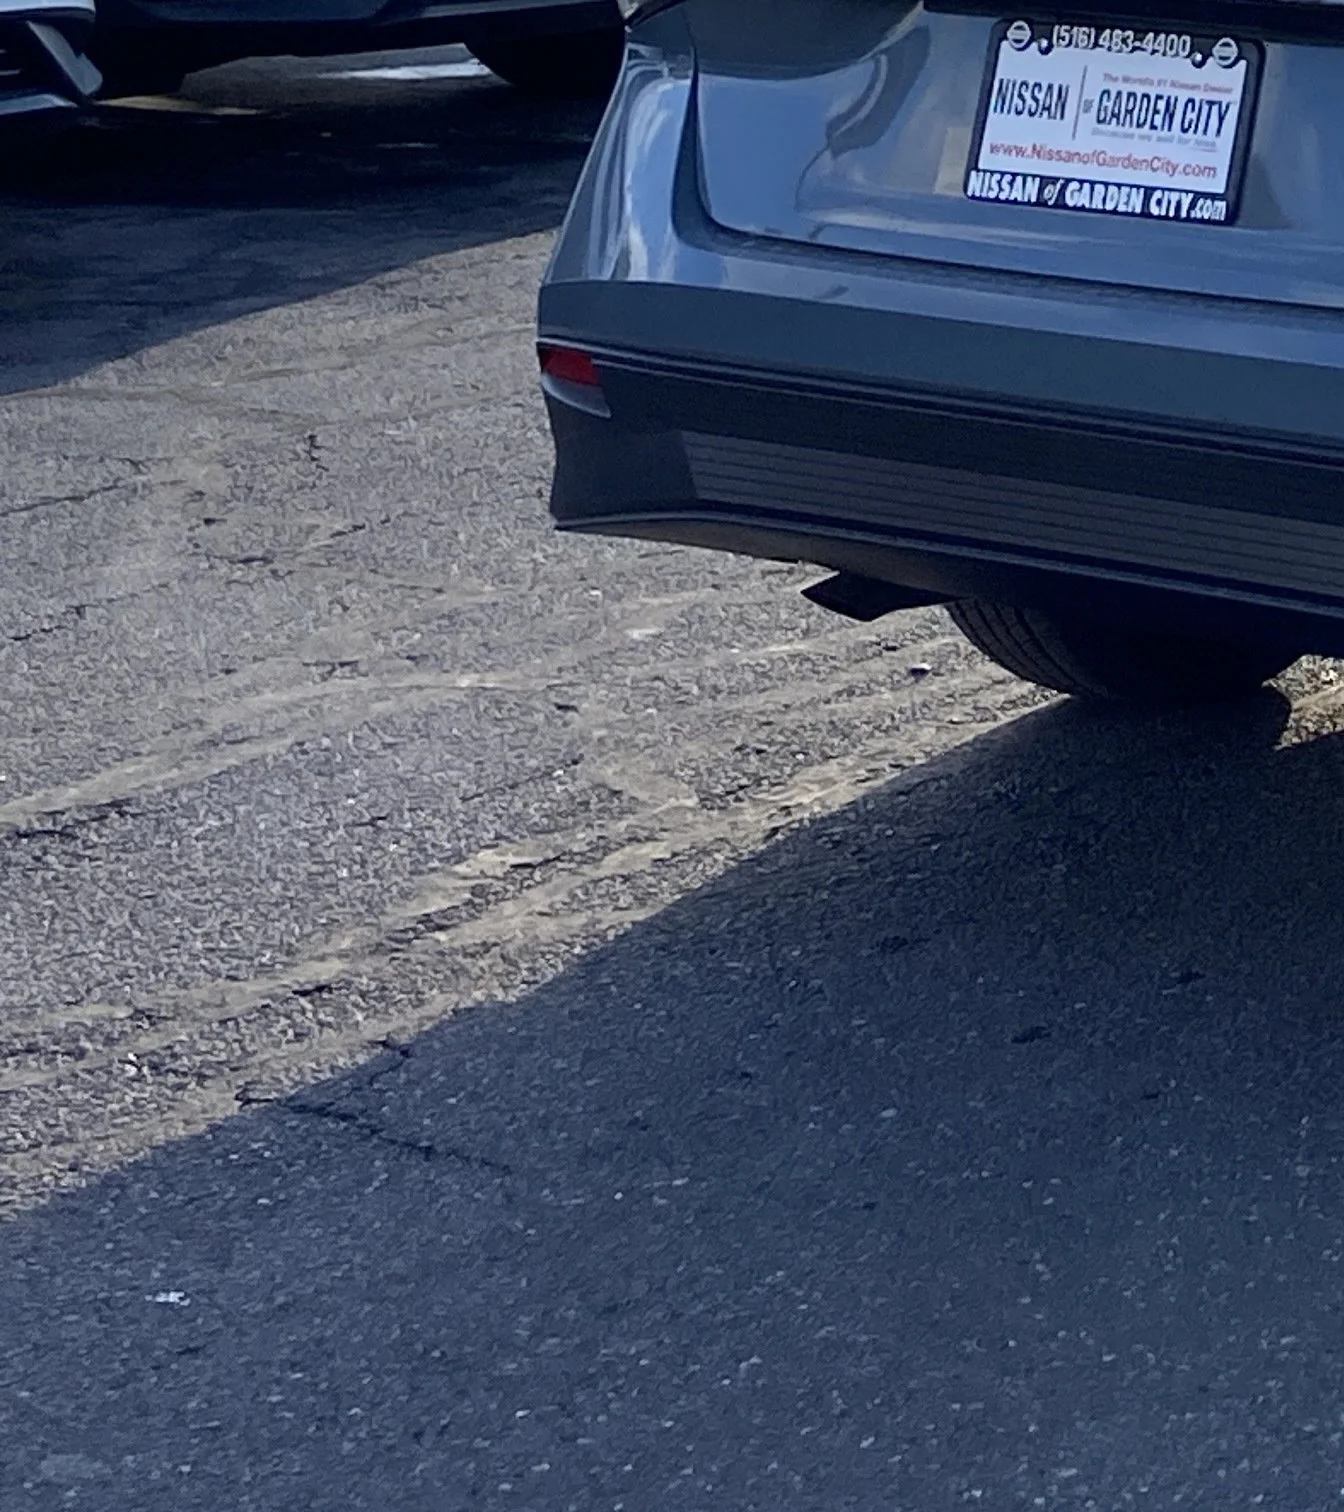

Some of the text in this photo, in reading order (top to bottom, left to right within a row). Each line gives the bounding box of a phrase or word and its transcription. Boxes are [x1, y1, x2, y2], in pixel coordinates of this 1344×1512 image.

[1053, 25, 1191, 57] (516) 483-4400
[993, 78, 1070, 121] NISSAN
[1096, 89, 1178, 132] GARDEN
[1181, 97, 1231, 137] CITY
[990, 142, 1218, 179] www.NissanofGardenCity.com
[967, 170, 1228, 221] NISSAN of GARDEN CITY.com
